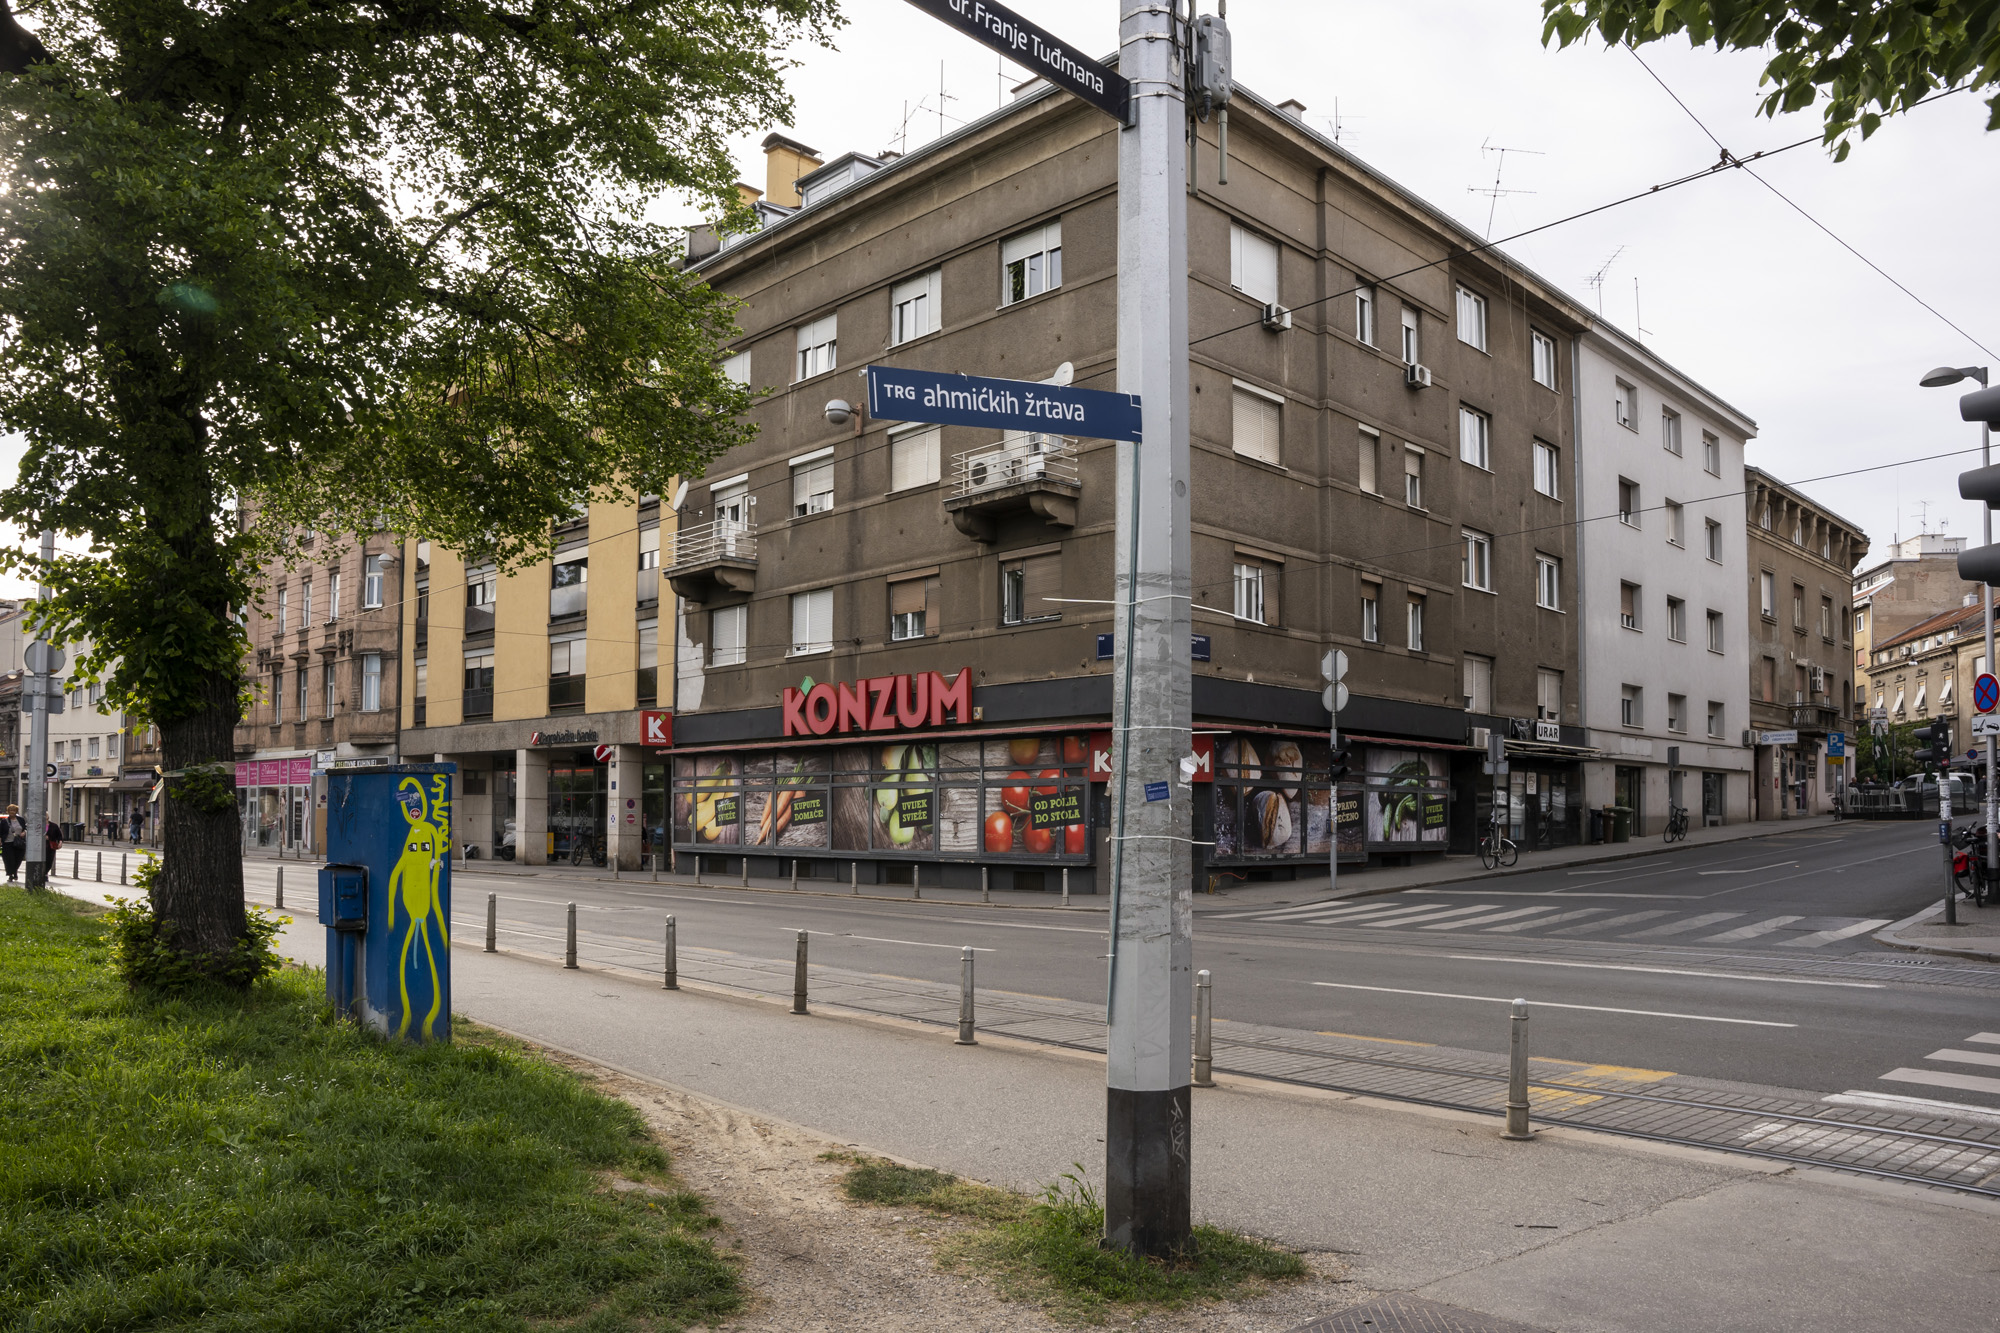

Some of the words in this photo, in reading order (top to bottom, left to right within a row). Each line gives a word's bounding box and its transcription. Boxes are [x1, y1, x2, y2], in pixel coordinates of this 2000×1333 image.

[975, 1, 1028, 50] Franje
[1031, 34, 1104, 95] Tuđmana
[884, 383, 916, 400] TRG
[923, 383, 1019, 415] ahmićkih
[1025, 392, 1085, 422] žrtava
[782, 666, 972, 736] KONZUM
[648, 716, 666, 738] K
[1538, 726, 1558, 739] URAR
[902, 799, 928, 811] UVIJEK
[1034, 801, 1048, 811] OD
[1337, 800, 1358, 812] PRAVO
[1426, 804, 1444, 814] UVIJEK
[902, 809, 928, 822] SVJEŽE
[1035, 813, 1049, 824] DO
[1050, 808, 1081, 821] STOLA
[1337, 811, 1359, 824] EČENO
[1426, 814, 1444, 825] SVJEŽE
